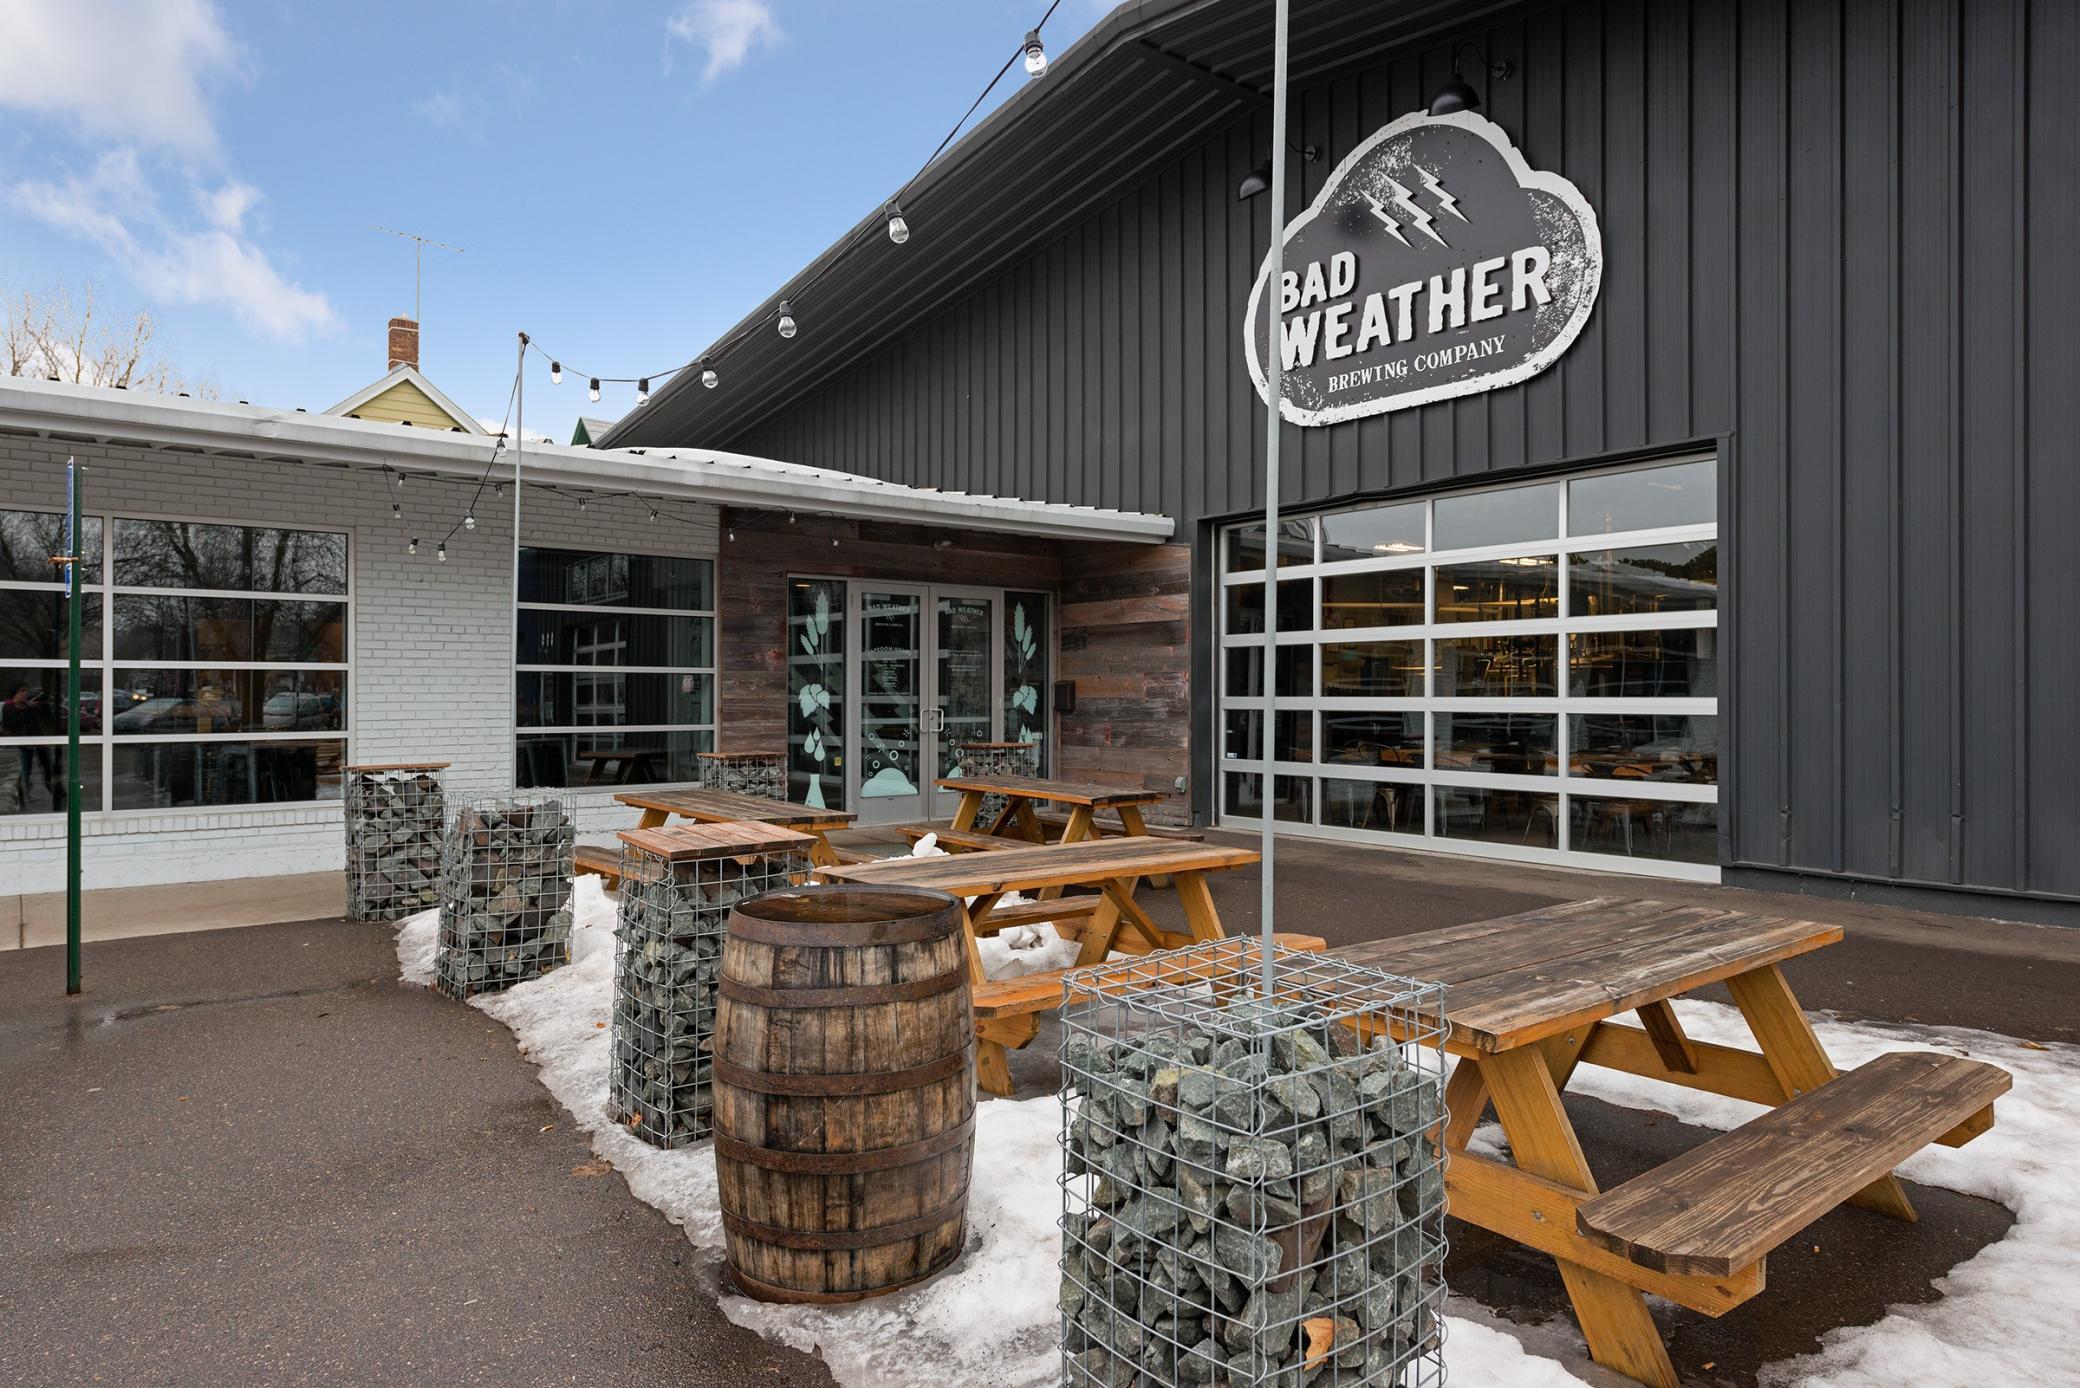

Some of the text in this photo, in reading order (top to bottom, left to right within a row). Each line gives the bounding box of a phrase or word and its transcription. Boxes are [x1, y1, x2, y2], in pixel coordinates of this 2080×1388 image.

[1280, 251, 1356, 314] BAD
[1280, 246, 1552, 371] WEATHER
[1328, 335, 1506, 393] BREWING COMPANY
[957, 606, 984, 617] WEATHER
